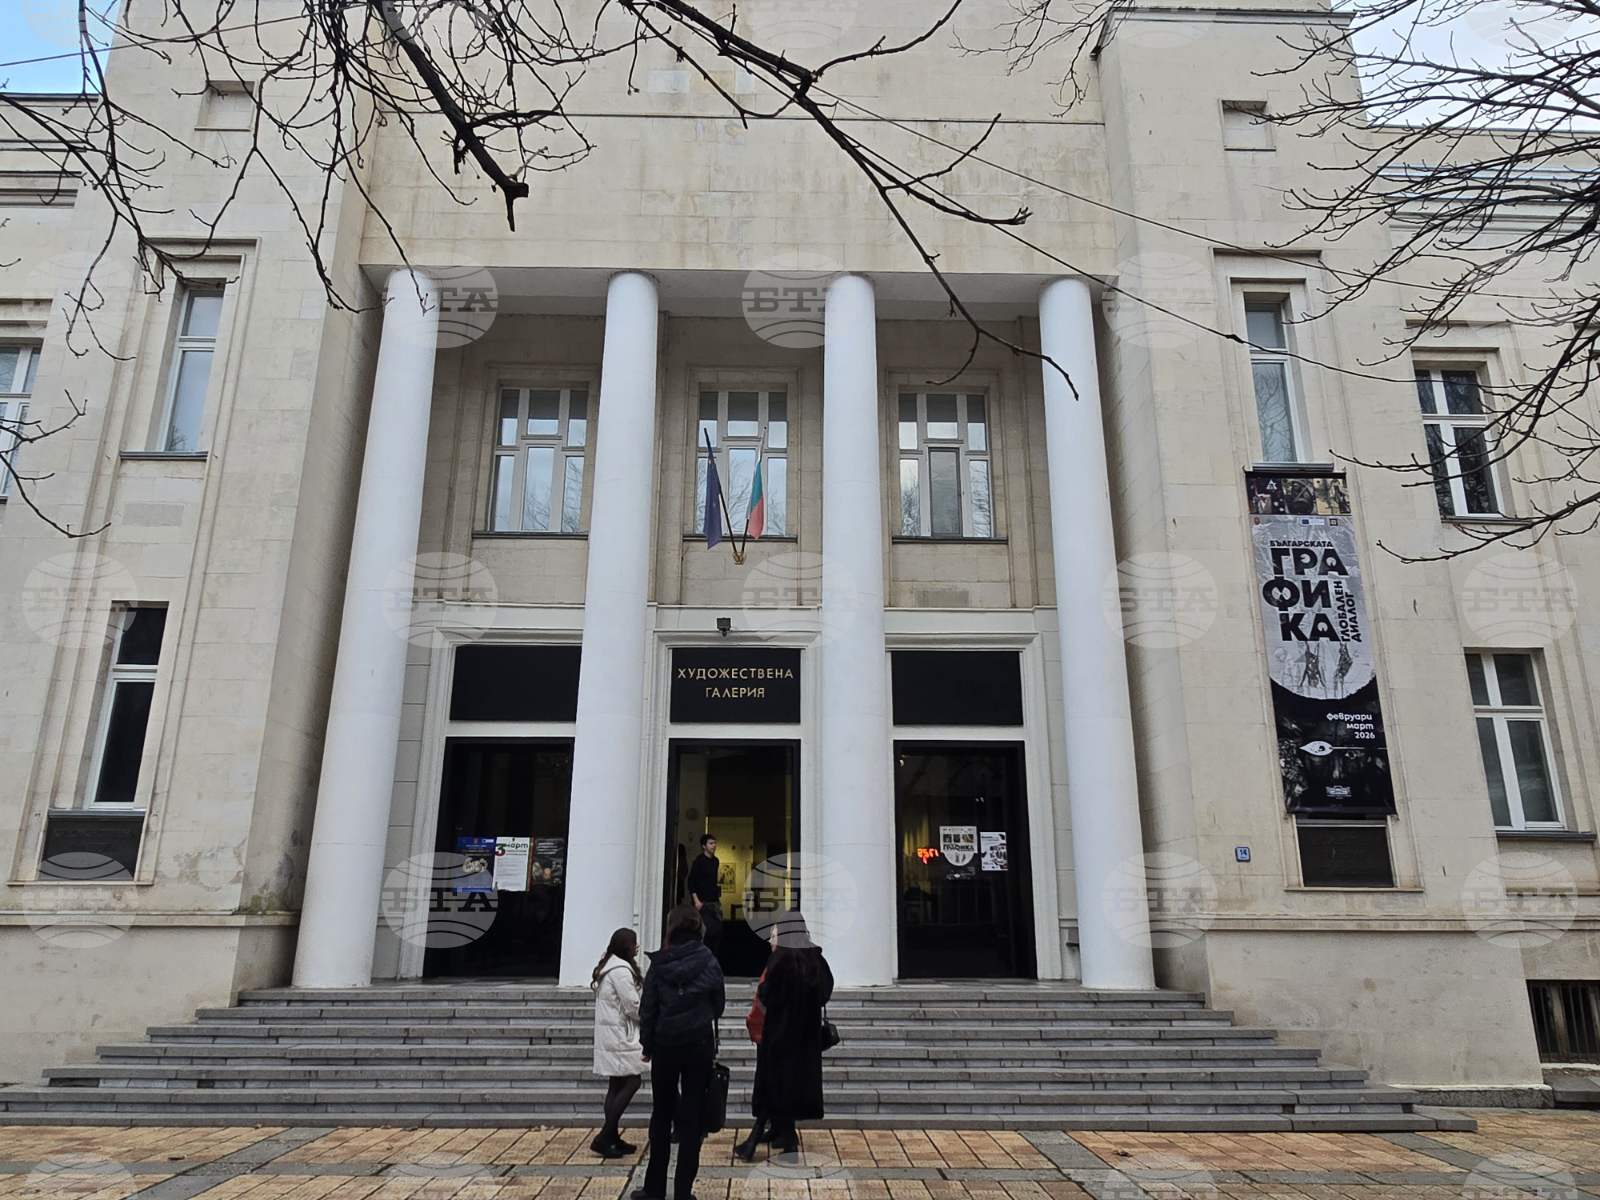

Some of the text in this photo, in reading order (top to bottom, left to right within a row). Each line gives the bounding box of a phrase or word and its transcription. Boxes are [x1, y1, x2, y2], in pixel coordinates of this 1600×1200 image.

[1270, 548, 1348, 575] ГРА
[1263, 576, 1331, 611] ФИ
[1334, 581, 1350, 641] ГЛОБАЛЕН
[1345, 592, 1362, 642] ДИАЛОГ
[1279, 613, 1341, 641] КА
[678, 668, 794, 680] ХУДОЖЕСТВЕНА
[705, 687, 765, 698] ГАЛЕРИЯ
[1326, 713, 1372, 721] февруари
